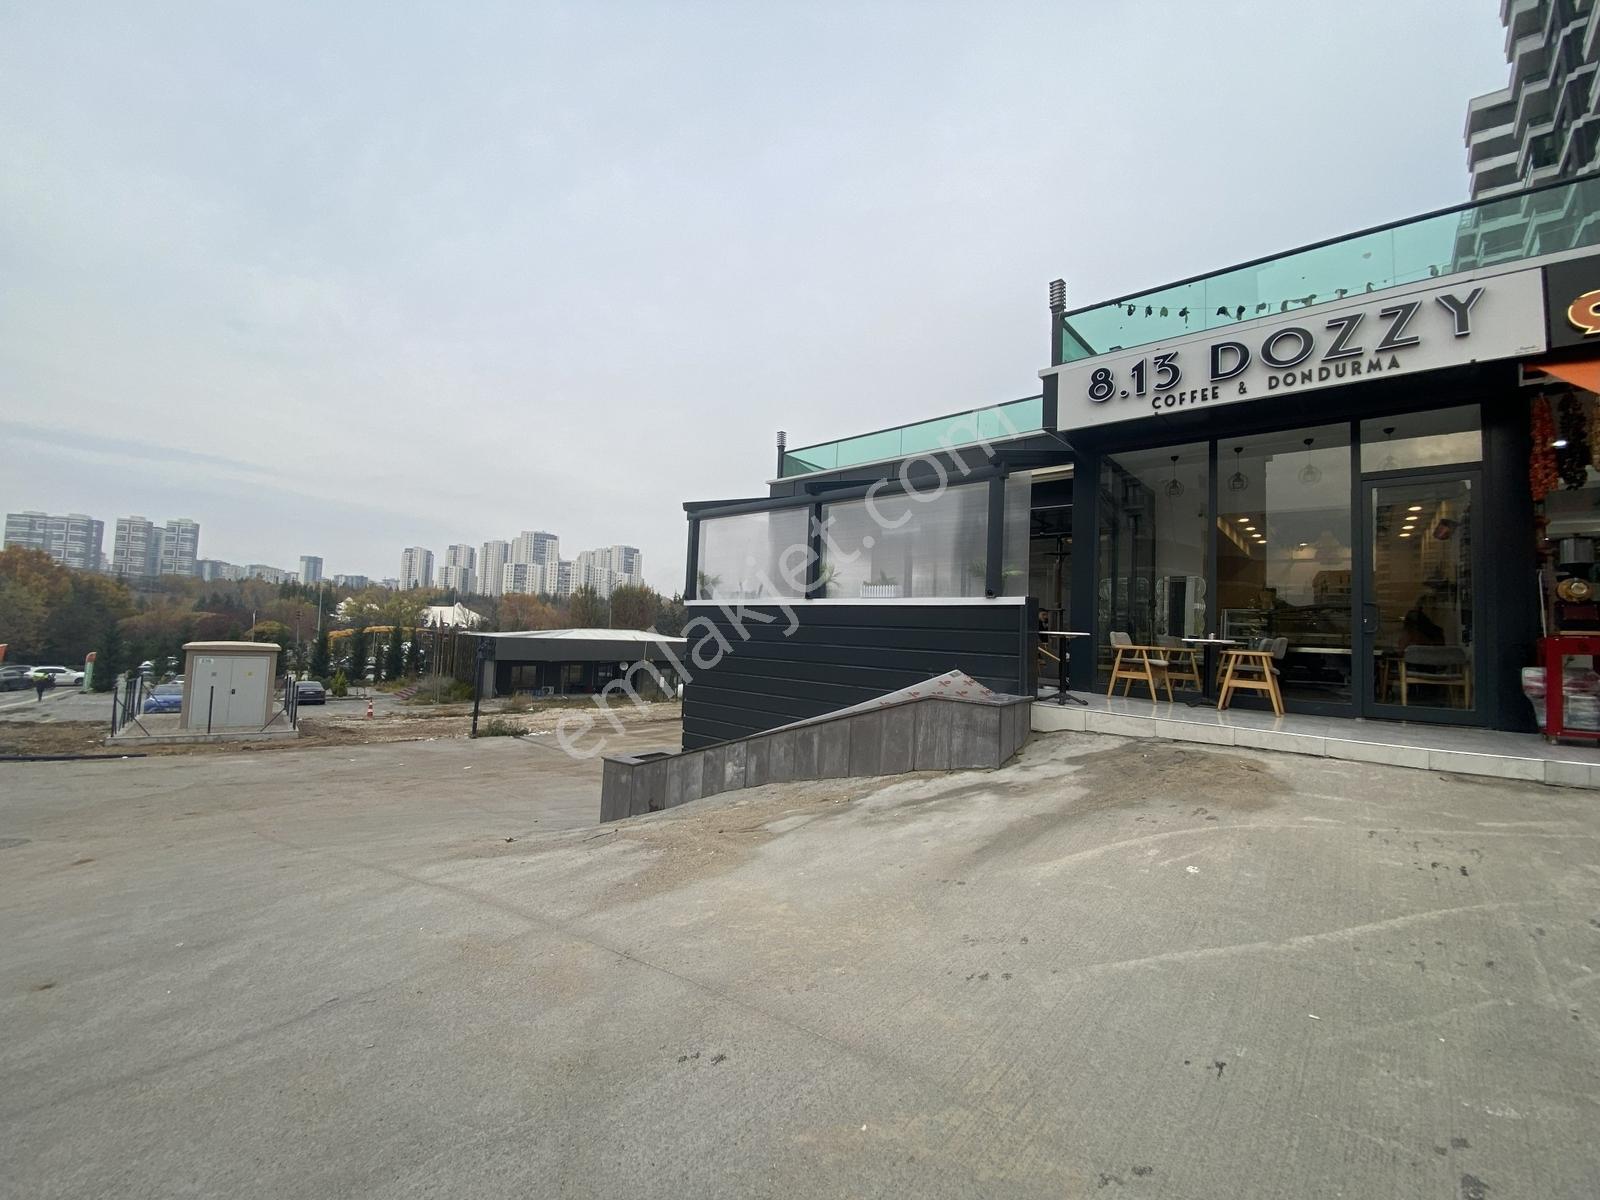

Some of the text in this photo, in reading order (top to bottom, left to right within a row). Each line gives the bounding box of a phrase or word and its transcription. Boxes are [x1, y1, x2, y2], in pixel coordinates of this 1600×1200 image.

[1088, 287, 1486, 403] 8.13 DOZZY
[1152, 354, 1401, 410] COFFEE & DONDURMA
